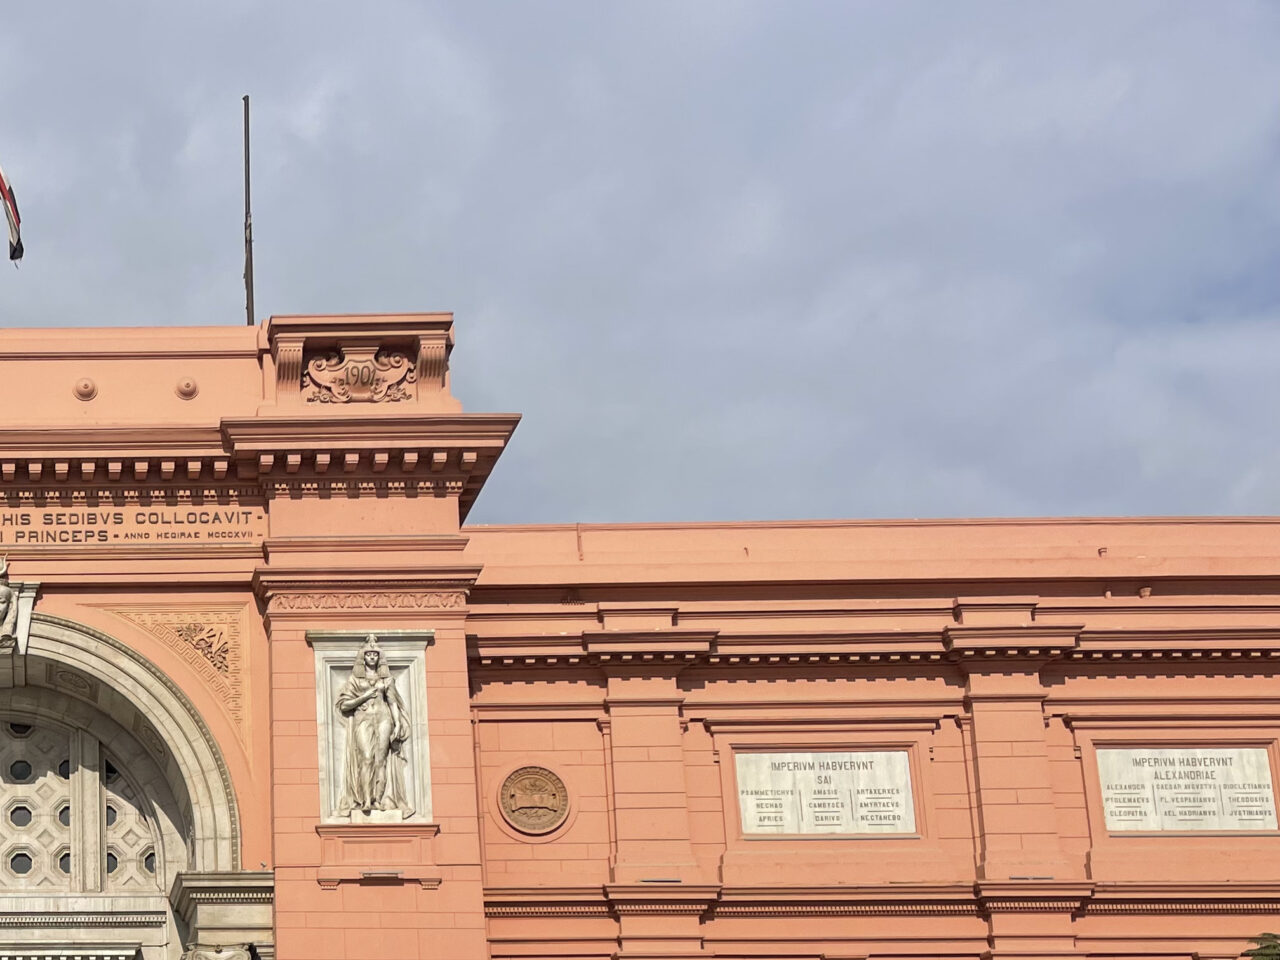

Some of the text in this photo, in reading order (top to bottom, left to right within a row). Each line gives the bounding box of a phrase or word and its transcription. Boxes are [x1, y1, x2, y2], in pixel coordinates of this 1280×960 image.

[344, 366, 376, 386] 1901
[2, 513, 31, 526] HIS
[42, 512, 124, 526] SEDIBVS
[135, 512, 252, 525] COLLOCAVIT
[14, 530, 108, 543] PRINCEPS
[770, 761, 874, 771] IMPERIVM HABVERVNT
[1132, 757, 1233, 767] IMPERIVM HABVERVNT
[817, 775, 832, 785] SAI
[1154, 770, 1216, 780] ALEXANDRIAE
